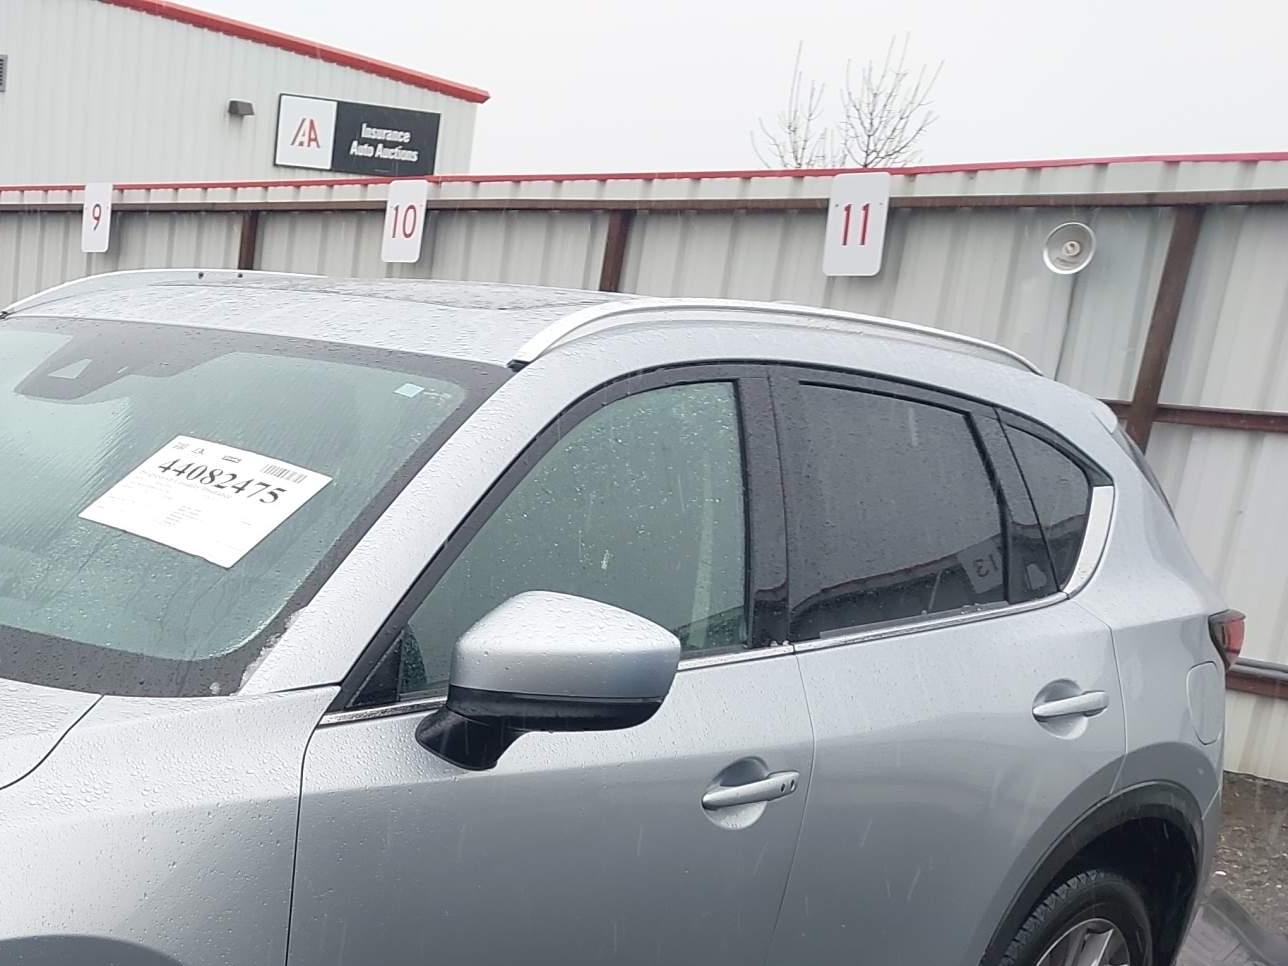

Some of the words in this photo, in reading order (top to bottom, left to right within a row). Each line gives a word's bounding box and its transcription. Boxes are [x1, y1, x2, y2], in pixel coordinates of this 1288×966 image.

[361, 123, 411, 143] Insurance
[349, 140, 374, 158] Auto
[375, 143, 419, 162] Auctions
[91, 203, 102, 231] 9
[392, 204, 417, 239] 10
[842, 203, 870, 246] 11
[158, 458, 286, 504] 44082475
